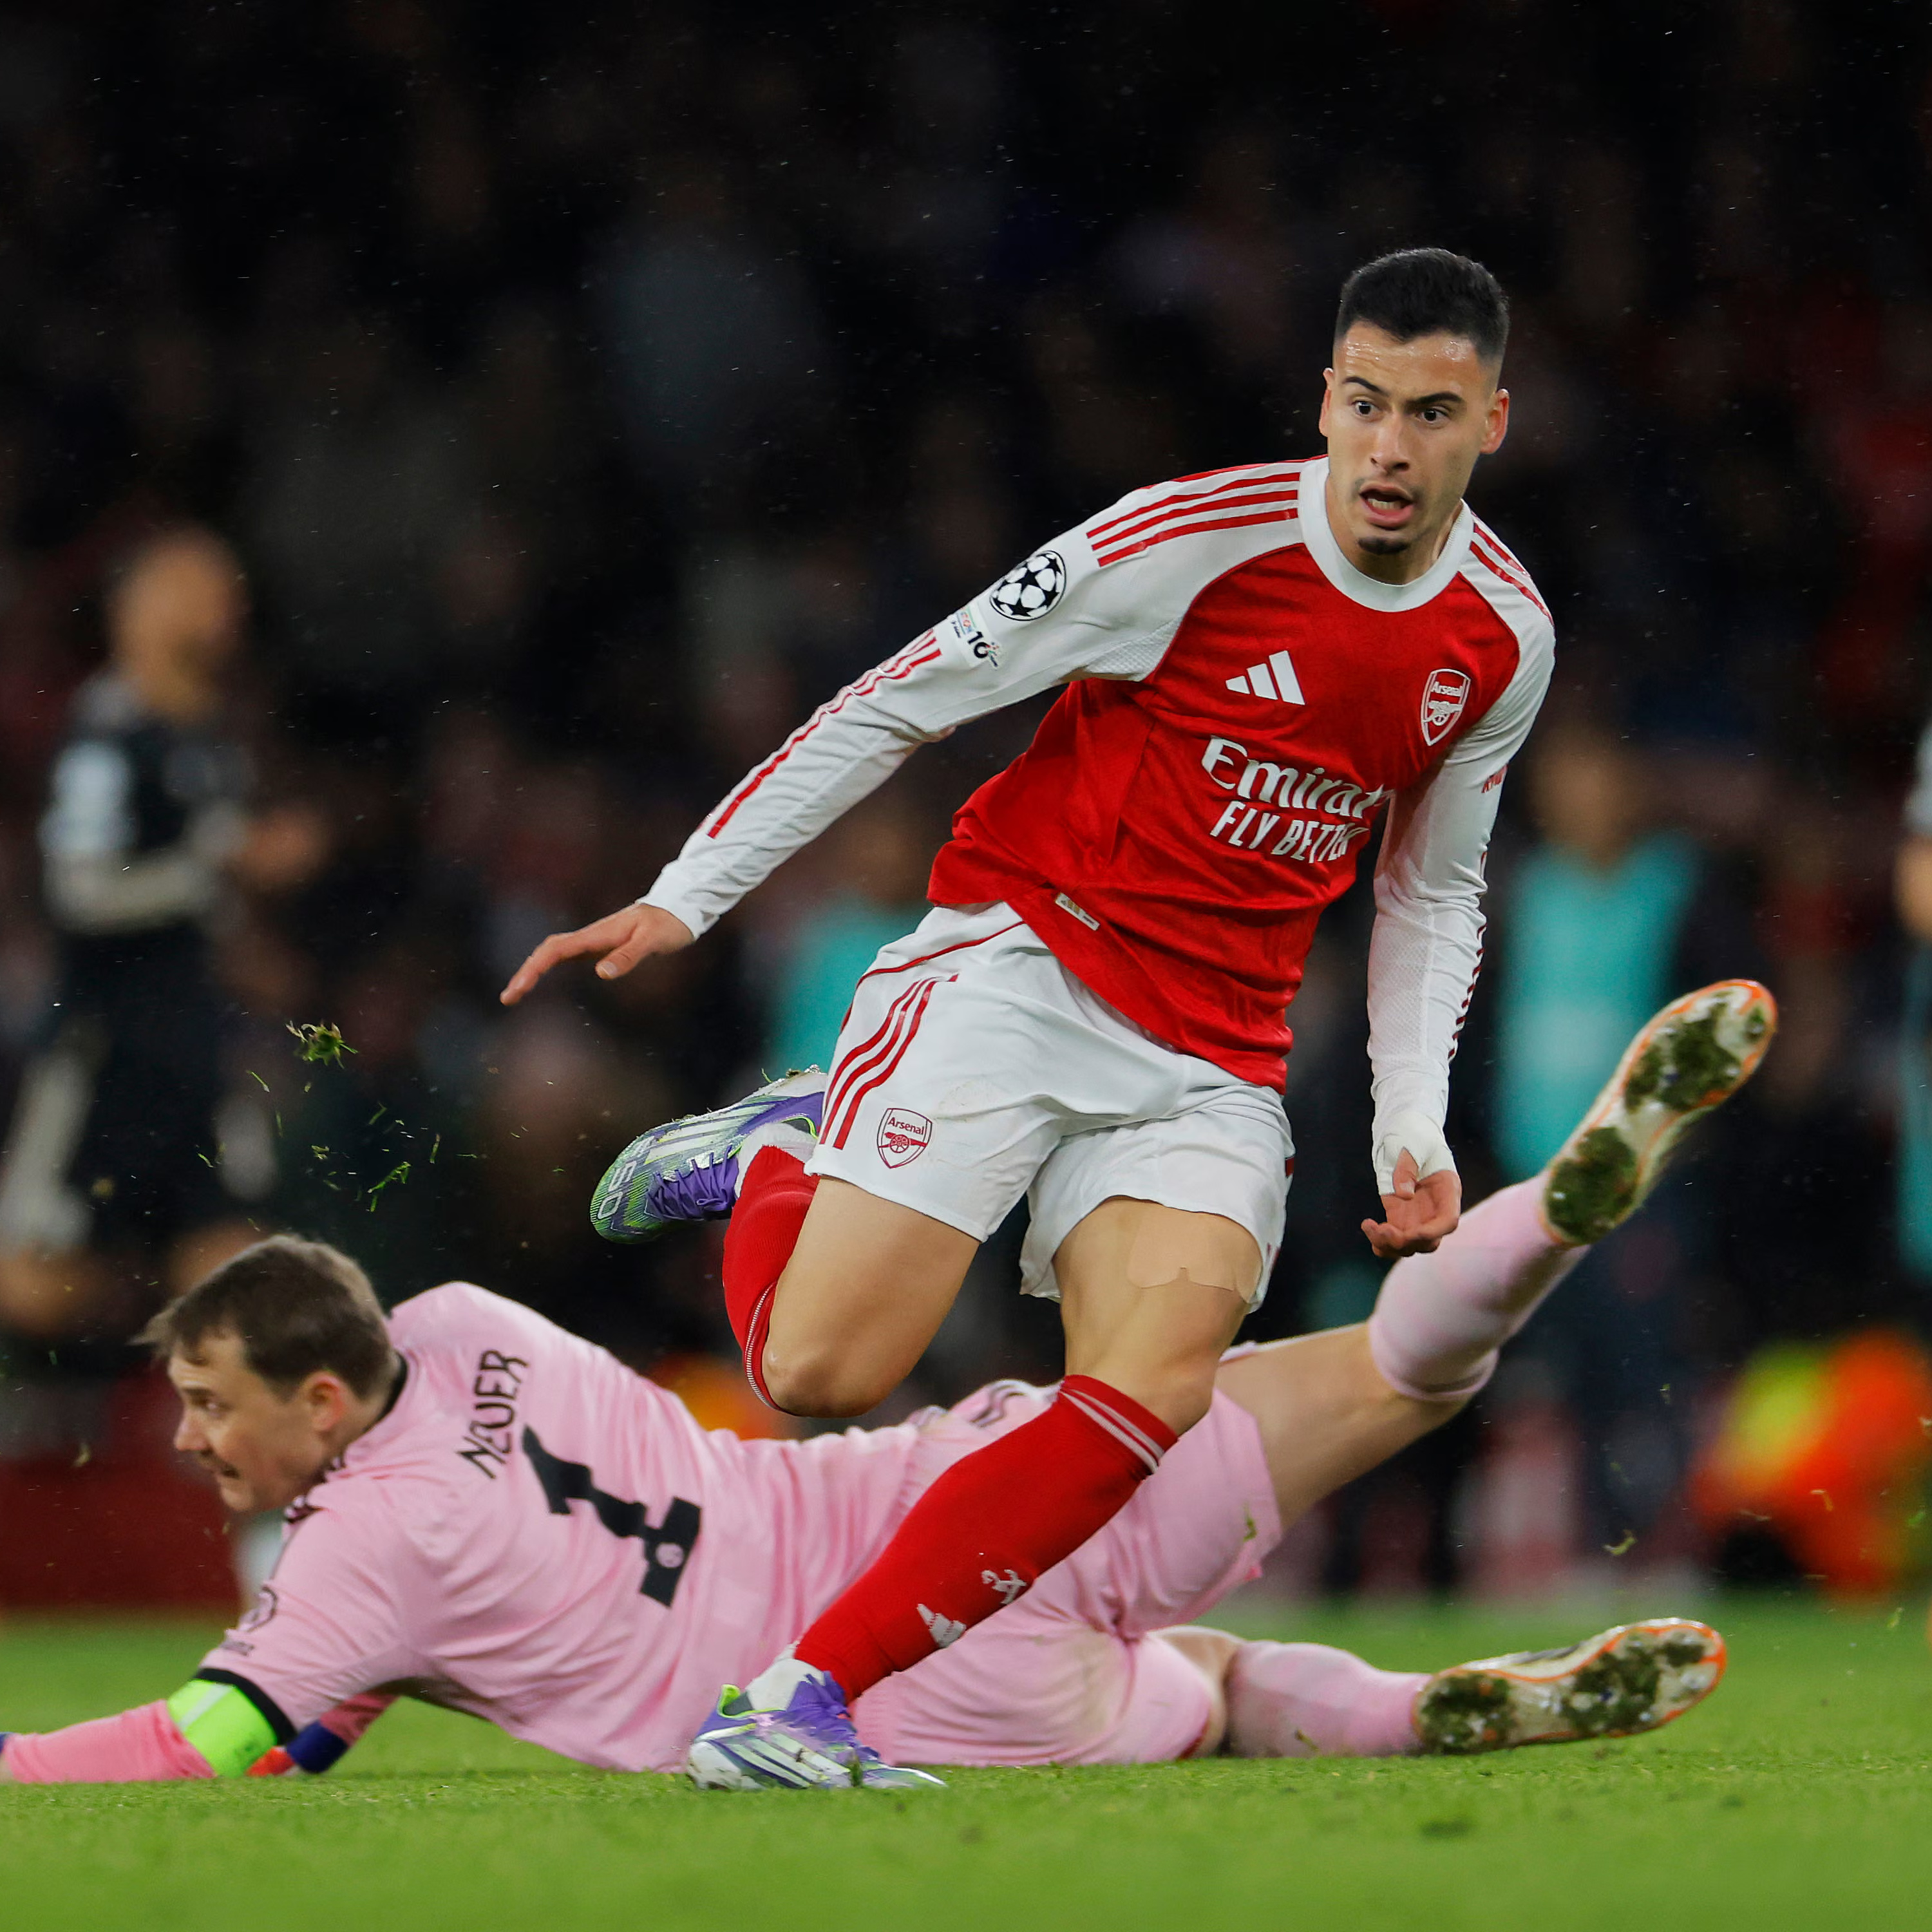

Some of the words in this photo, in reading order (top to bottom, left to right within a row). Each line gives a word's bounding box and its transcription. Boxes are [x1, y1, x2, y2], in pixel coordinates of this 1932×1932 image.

[1201, 735, 1385, 819] Emirat
[1209, 800, 1281, 849] FLY
[887, 1117, 925, 1135] Arsenal
[456, 1350, 529, 1479] NEUER
